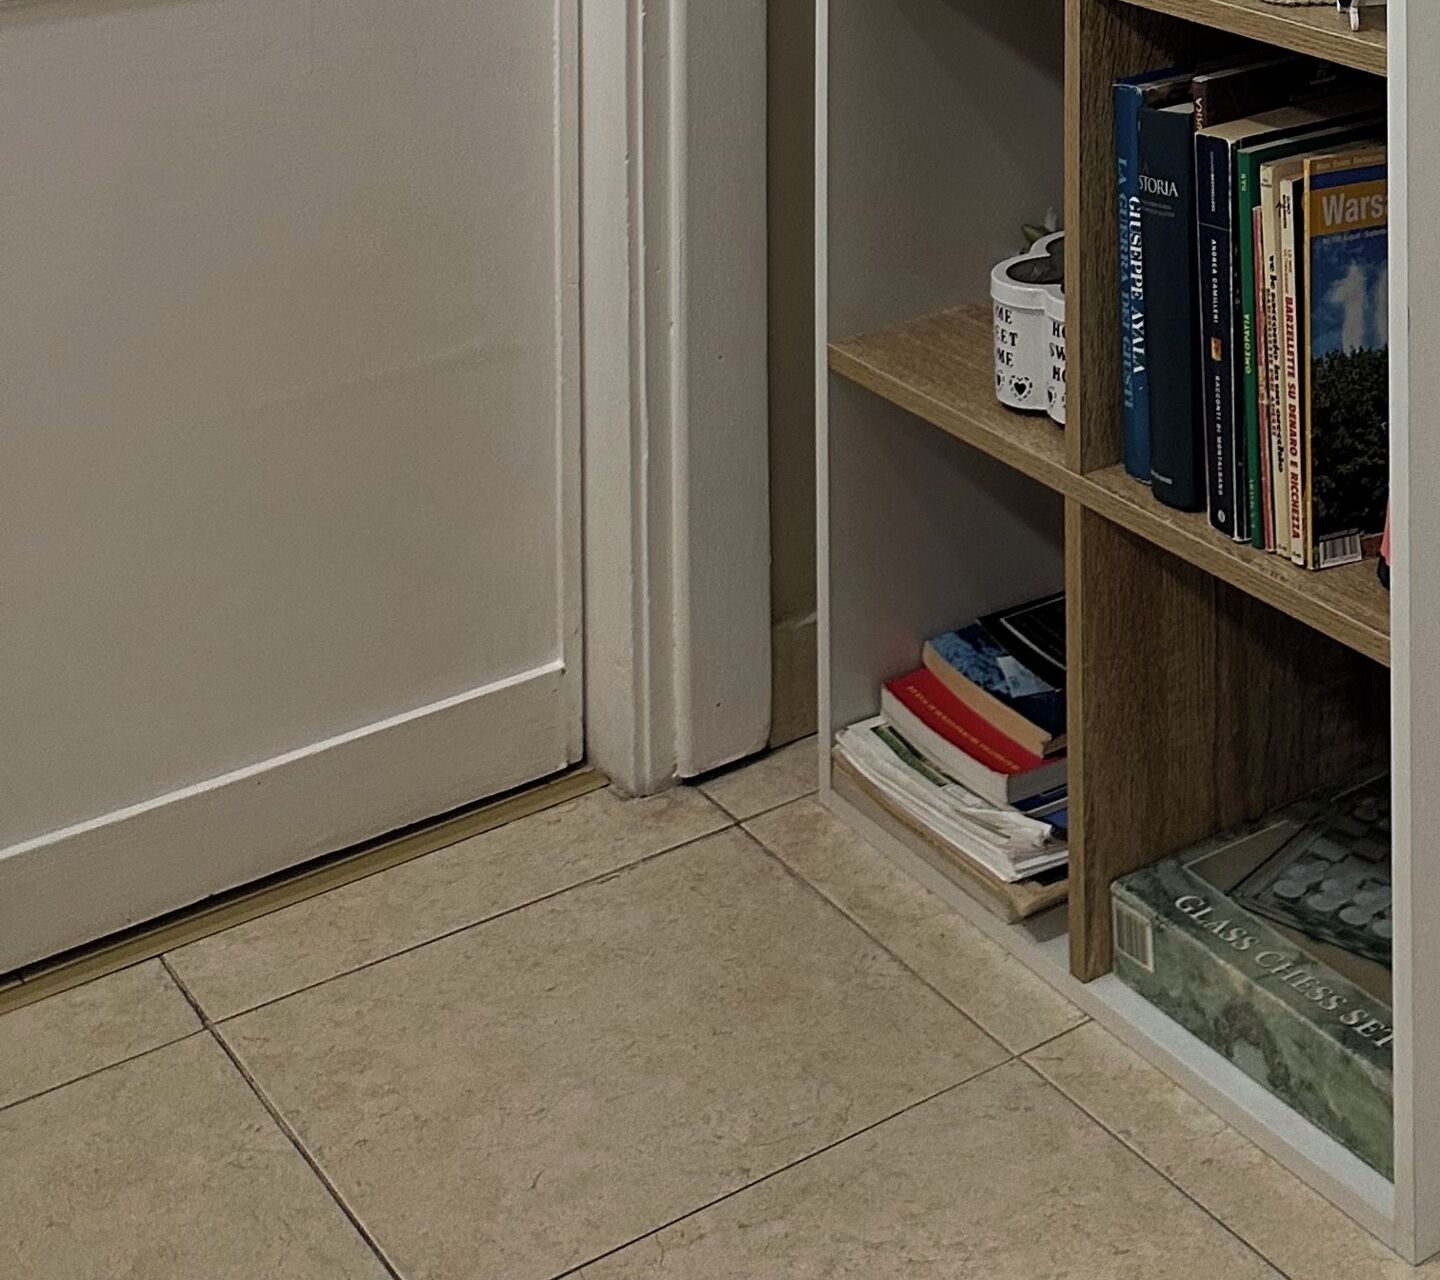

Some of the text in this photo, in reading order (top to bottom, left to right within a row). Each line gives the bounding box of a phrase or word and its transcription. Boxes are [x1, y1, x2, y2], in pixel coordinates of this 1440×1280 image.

[1118, 157, 1128, 186] LA
[1321, 192, 1388, 226] Wars
[1129, 195, 1147, 375] GIUSEPPE AYALA
[1210, 238, 1219, 324] ANDREA CAMILLERI
[1243, 313, 1251, 375] OMEOPATIA
[1285, 296, 1296, 381] BARZELLETTE
[1214, 374, 1222, 420] RACCONTI
[1287, 383, 1296, 400] SU
[1288, 403, 1298, 457] DENARO
[1216, 434, 1224, 496] MONTALBANO
[1289, 460, 1298, 468] E
[1290, 470, 1301, 539] RICCHEZZA
[1175, 895, 1393, 1048] GLASS CHESS SET
